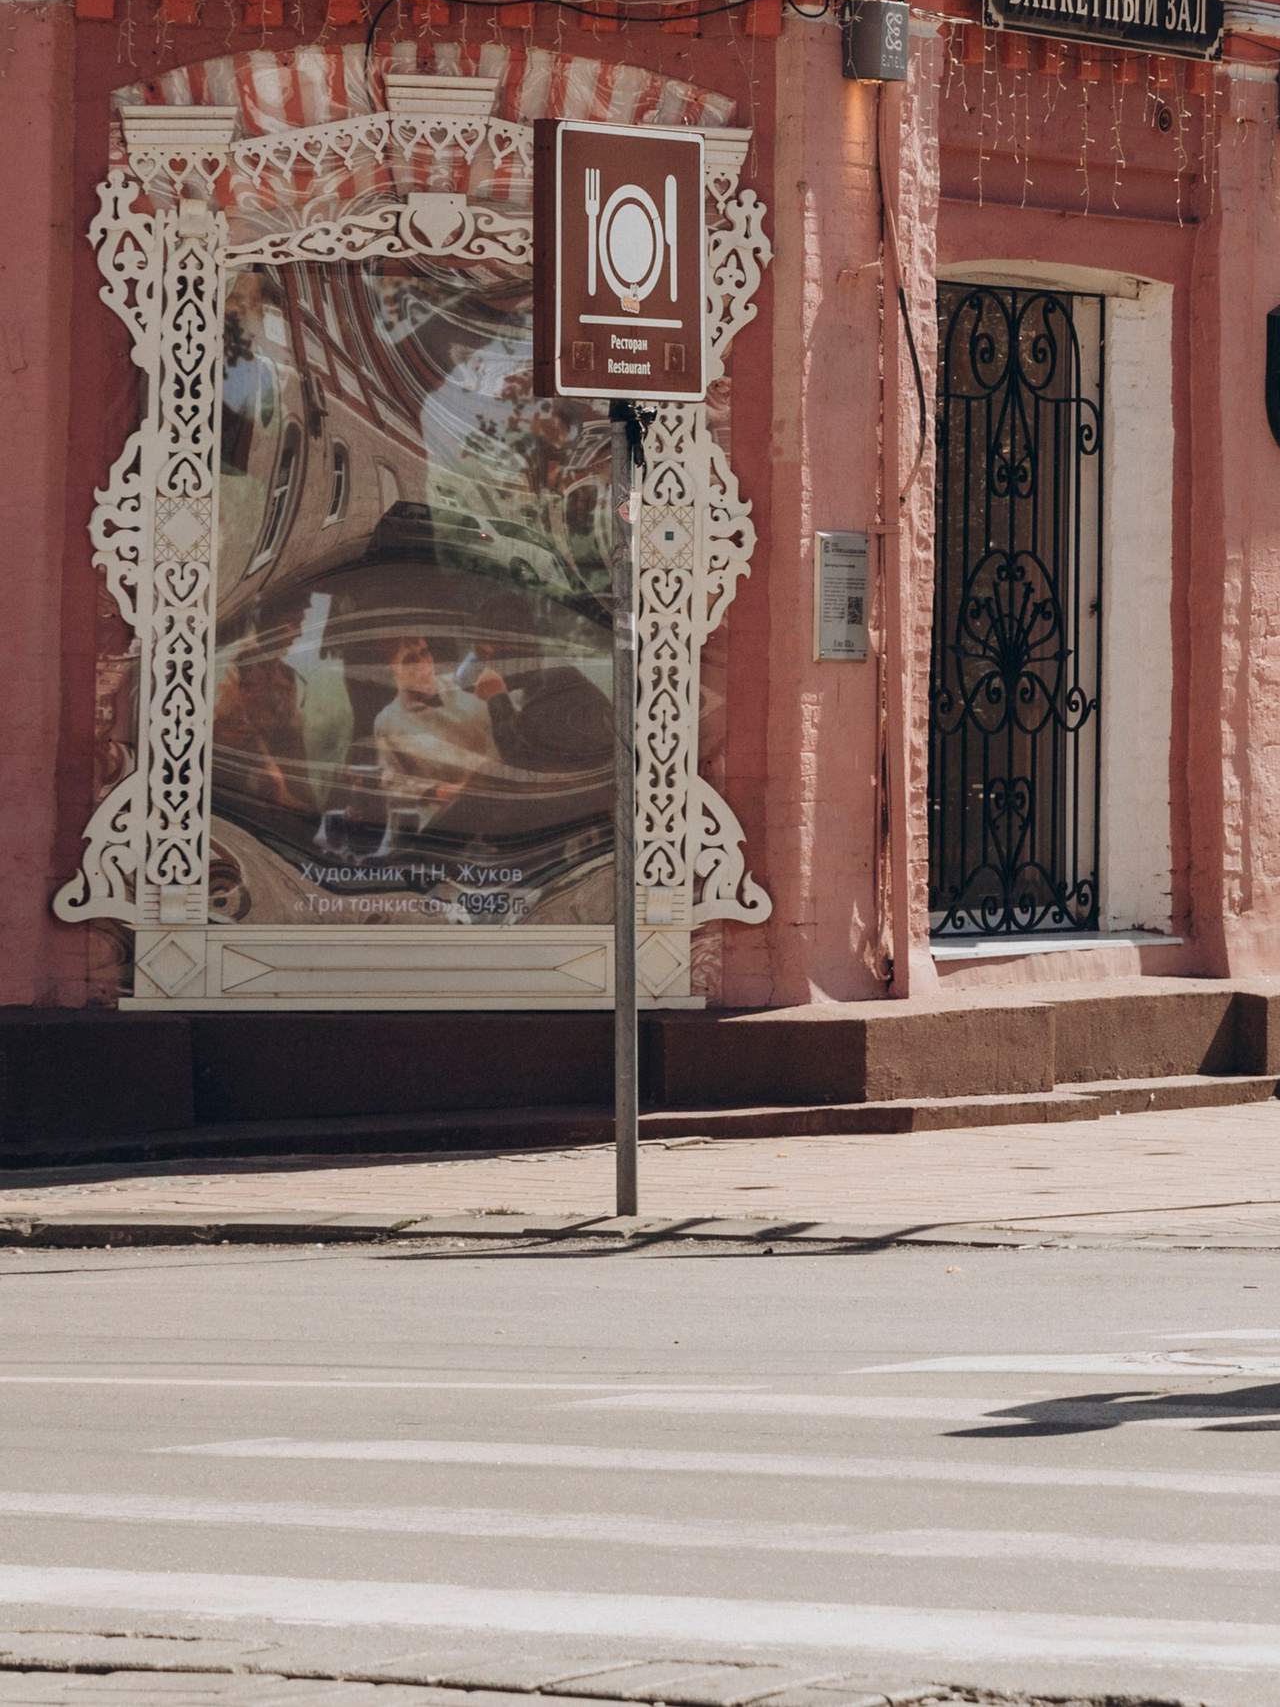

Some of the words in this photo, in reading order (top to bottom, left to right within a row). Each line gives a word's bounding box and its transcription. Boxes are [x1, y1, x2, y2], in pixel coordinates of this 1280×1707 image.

[611, 334, 648, 354] Ресторан
[607, 358, 651, 375] Restaurant
[300, 862, 404, 886] Художник
[411, 863, 451, 882] Н.Н.
[456, 863, 523, 886] Жуков
[293, 894, 343, 916] «Три
[349, 898, 452, 913] танкиста»
[459, 894, 510, 914] 1945
[513, 898, 530, 914] г.
